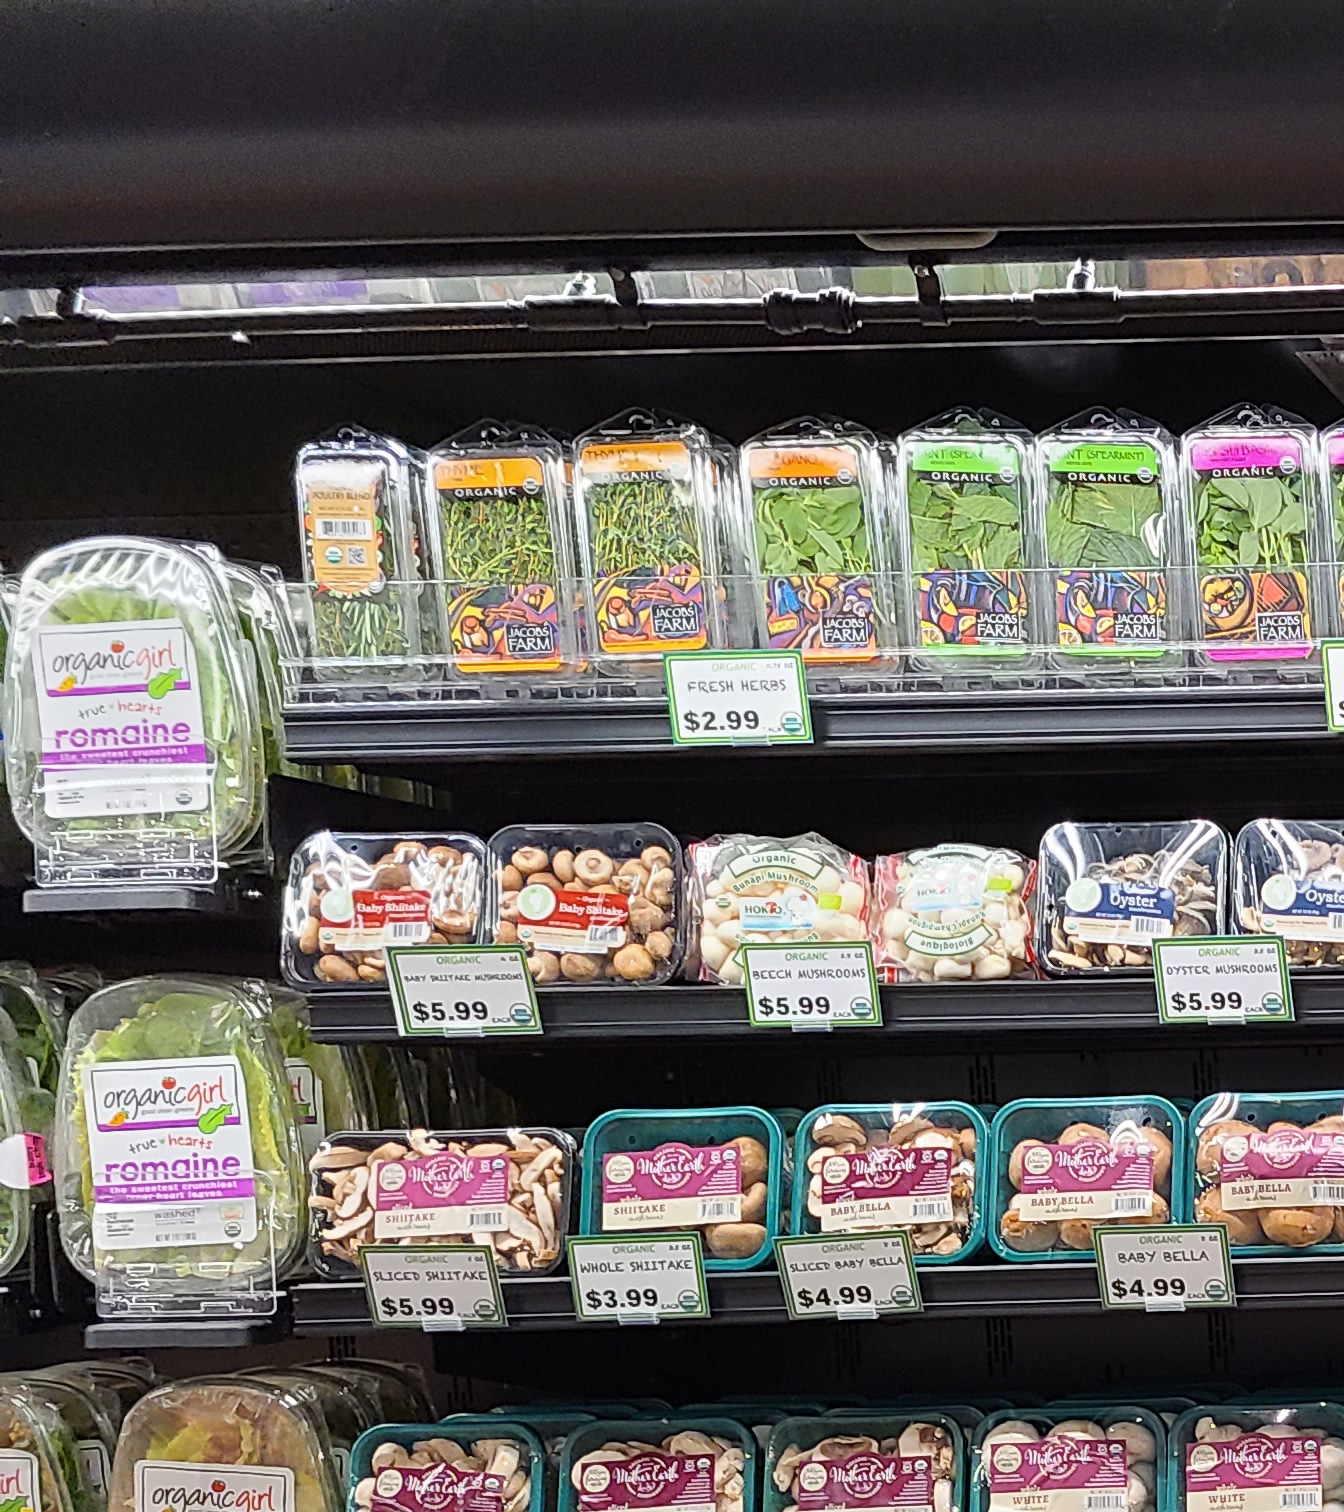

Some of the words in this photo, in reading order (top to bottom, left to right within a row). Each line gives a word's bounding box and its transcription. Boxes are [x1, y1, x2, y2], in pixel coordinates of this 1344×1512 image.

[932, 472, 993, 483] ORGANIC
[53, 640, 177, 684] organicgirl
[687, 681, 734, 693] FRESH
[741, 680, 787, 692] HERBS
[684, 710, 760, 732] $2.99
[55, 719, 191, 749] romaine
[752, 854, 797, 866] Organic
[356, 903, 382, 913] Baby
[384, 902, 426, 913] Shiitake
[744, 901, 784, 916] HOKTO
[1110, 894, 1157, 908] Oyster
[753, 968, 792, 980] BEECH
[798, 967, 866, 979] MUSHROOMS
[1167, 965, 1210, 976] OYSTER
[1215, 963, 1278, 975] MUSHROOMS
[758, 996, 831, 1017] $5.99
[1171, 992, 1242, 1013] $5.99
[413, 1000, 488, 1023] $5.99
[104, 1076, 228, 1119] organicgirl
[105, 1152, 240, 1183] romaine
[386, 1212, 436, 1223] SHIITAKE
[1117, 1251, 1156, 1264] BABY
[1164, 1250, 1209, 1263] BELLA
[580, 1261, 624, 1273] WHOLE
[630, 1259, 692, 1271] SHIITAKE
[374, 1271, 421, 1282] SLICED
[425, 1270, 488, 1281] SHIITAKE
[797, 1285, 872, 1307] $4.99
[1111, 1278, 1186, 1299] $4.99
[381, 1297, 454, 1317] $5.99
[586, 1288, 658, 1310] $3.99
